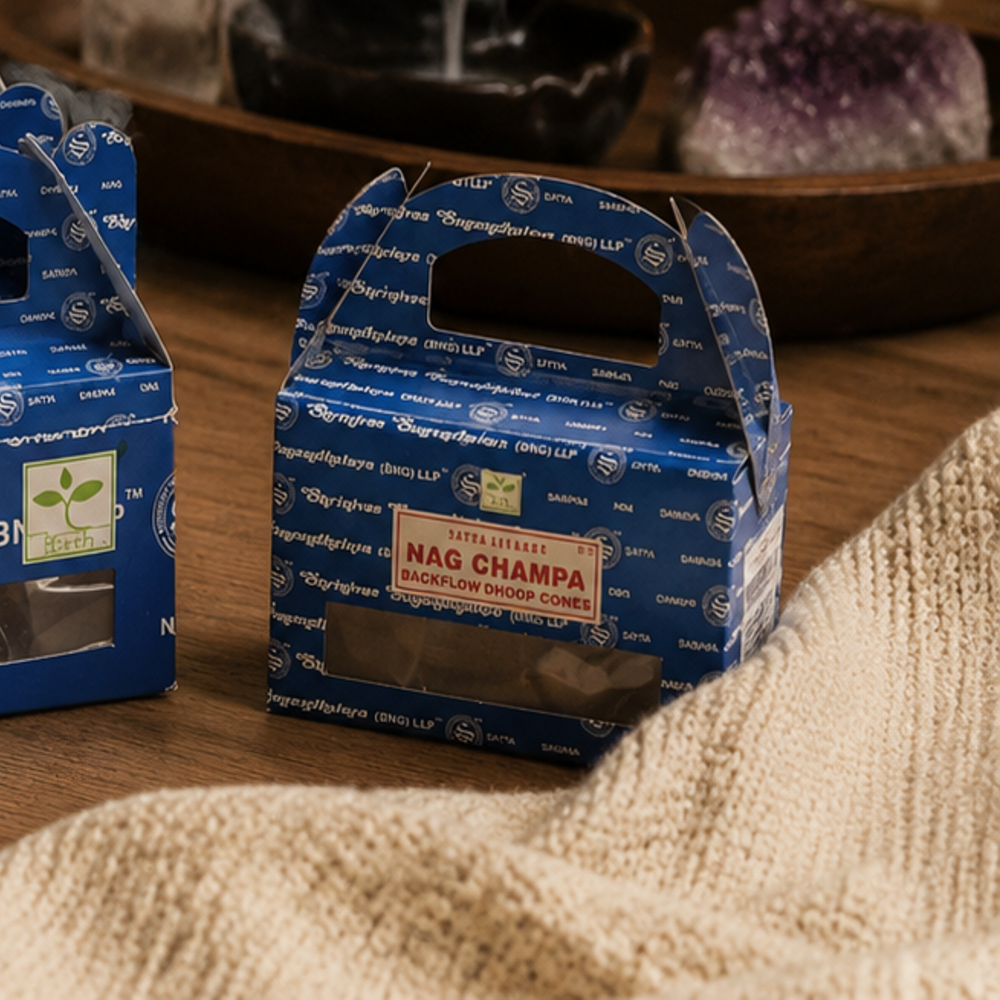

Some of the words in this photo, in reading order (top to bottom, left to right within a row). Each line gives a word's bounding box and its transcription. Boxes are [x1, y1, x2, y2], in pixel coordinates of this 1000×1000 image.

[417, 468, 441, 481] LLP
[406, 542, 462, 571] NAG
[472, 553, 585, 592] CHAMPA
[484, 582, 536, 604] DHOOP
